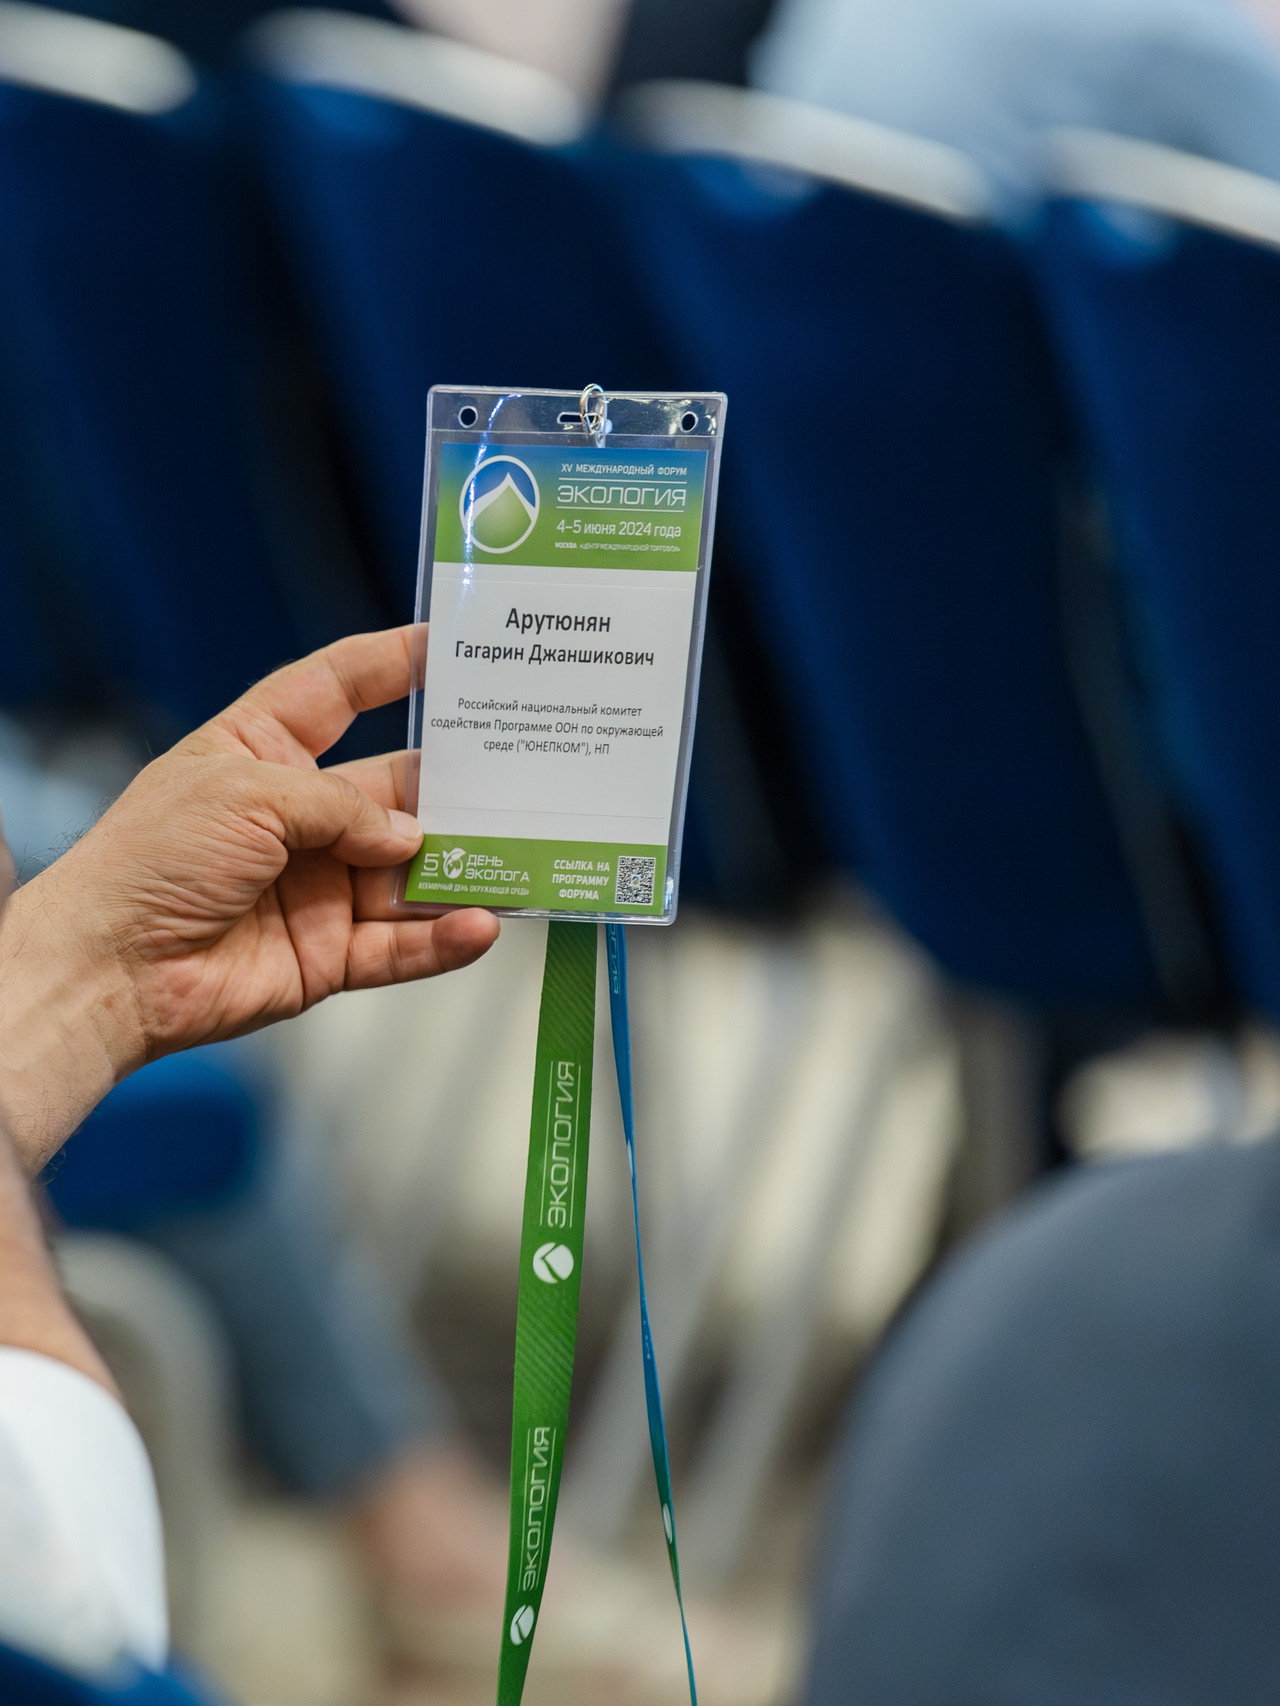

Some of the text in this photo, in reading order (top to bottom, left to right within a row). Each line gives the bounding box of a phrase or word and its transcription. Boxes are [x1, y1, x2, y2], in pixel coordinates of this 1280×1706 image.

[561, 463, 687, 476] XV МЕЖДУНАРОДНЫЙ ФОРУМ
[557, 485, 686, 507] ЭКОЛОГИЯ
[584, 523, 616, 535] июня
[618, 521, 651, 536] 2024
[654, 526, 681, 538] года
[505, 608, 611, 634] Арутюнян
[455, 641, 654, 666] Гагарин Джаншикович
[458, 698, 642, 717] Российский национальный комитет
[430, 717, 664, 738] содействия Программе ООН по окружающей
[483, 740, 610, 756] среде ("ЮНЕПКОМ"), НП
[423, 853, 440, 871] 5
[466, 854, 504, 867] ДЕНЬ
[553, 859, 610, 872] ССЫЛКА НА
[464, 868, 530, 882] ЭКОЛОГА
[551, 873, 610, 887] ПРОГРАММУ
[558, 888, 599, 900] ФОРУМА
[547, 1061, 575, 1229] ЭКОЛОГИЯ
[522, 1426, 551, 1592] ЭКОЛОГИЯ
